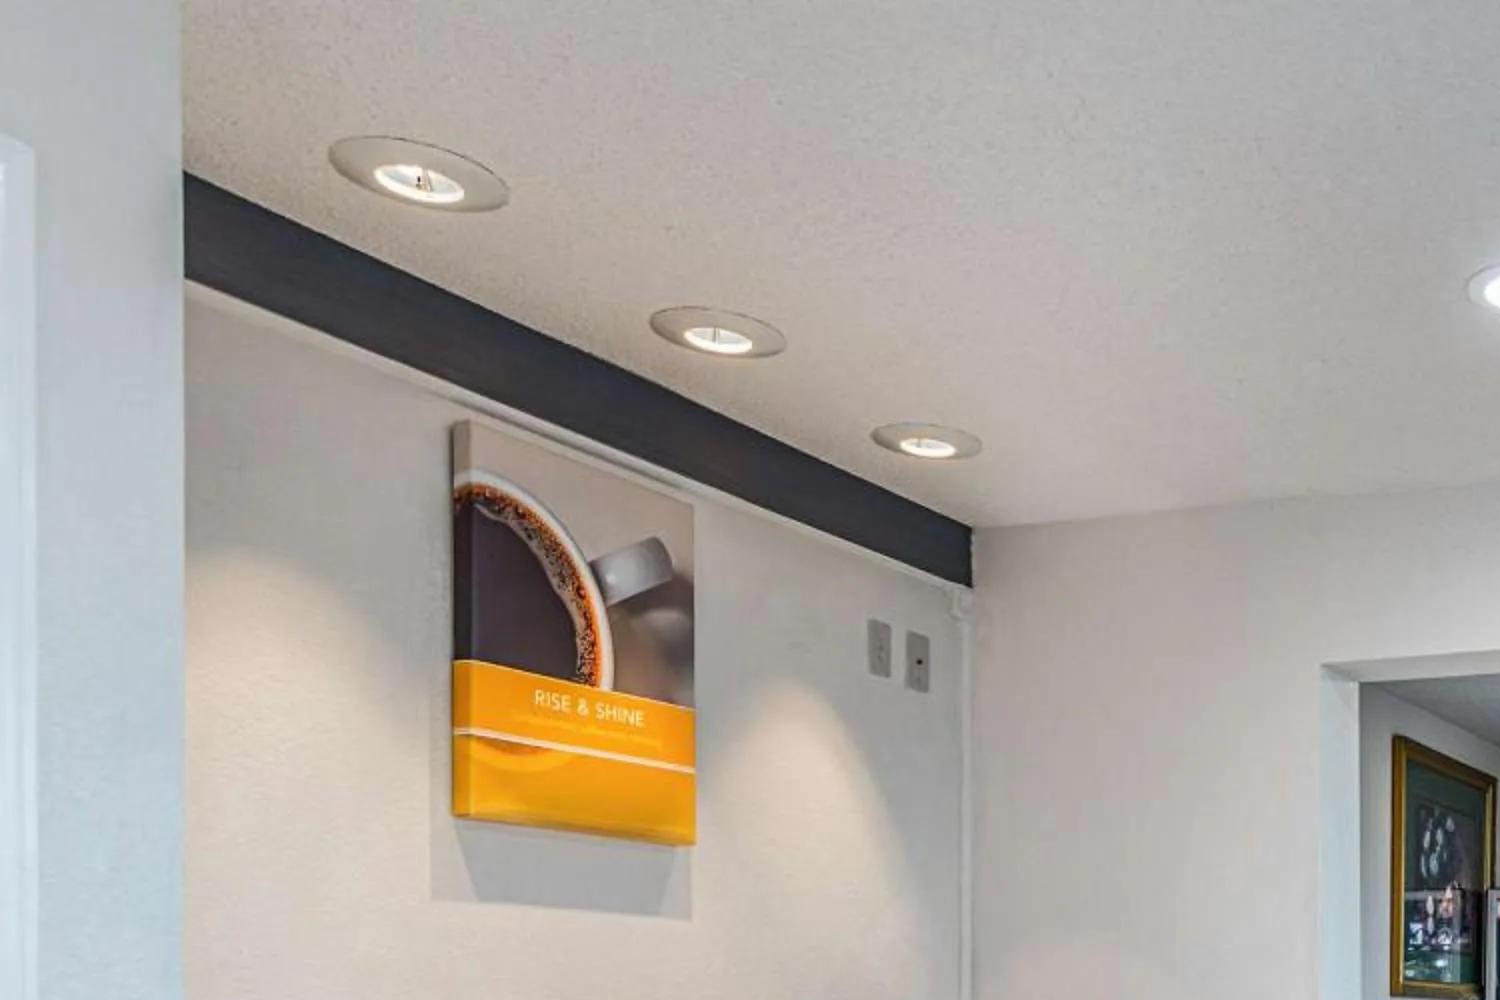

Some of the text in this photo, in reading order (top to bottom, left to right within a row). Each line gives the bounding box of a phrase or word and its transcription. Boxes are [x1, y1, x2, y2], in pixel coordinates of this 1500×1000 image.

[535, 690, 645, 727] RISE & SHINE
